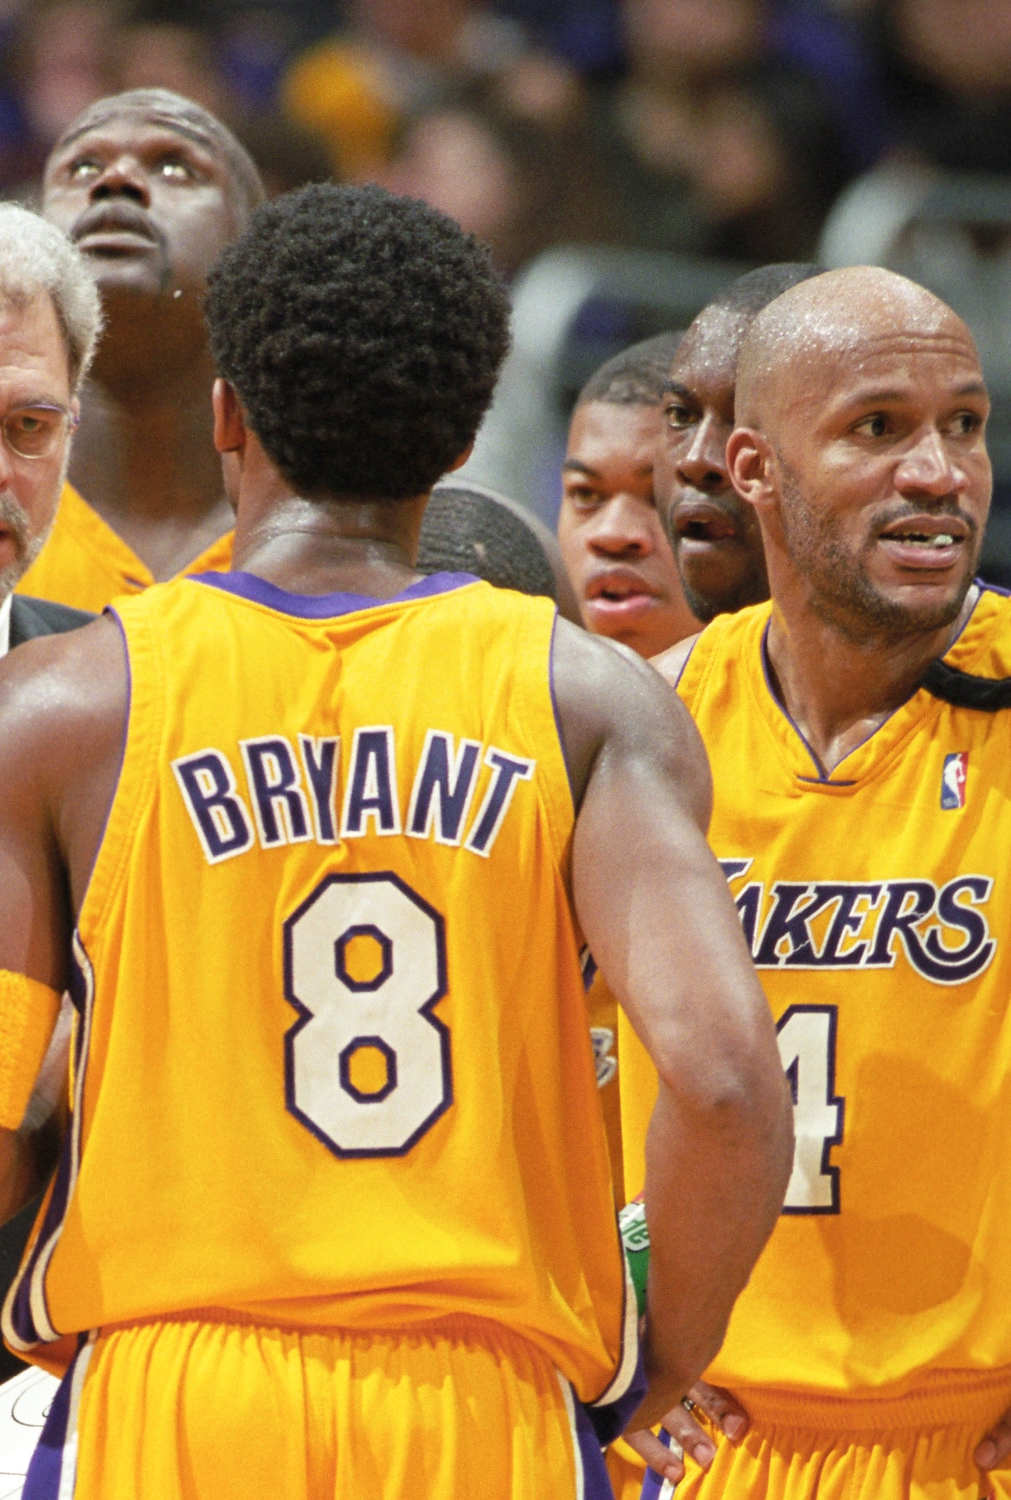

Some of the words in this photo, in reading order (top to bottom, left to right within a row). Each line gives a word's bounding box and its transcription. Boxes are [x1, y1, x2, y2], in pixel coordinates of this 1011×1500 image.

[171, 725, 537, 865] BRYANT
[717, 857, 997, 986] AKERS
[282, 870, 454, 1160] 8
